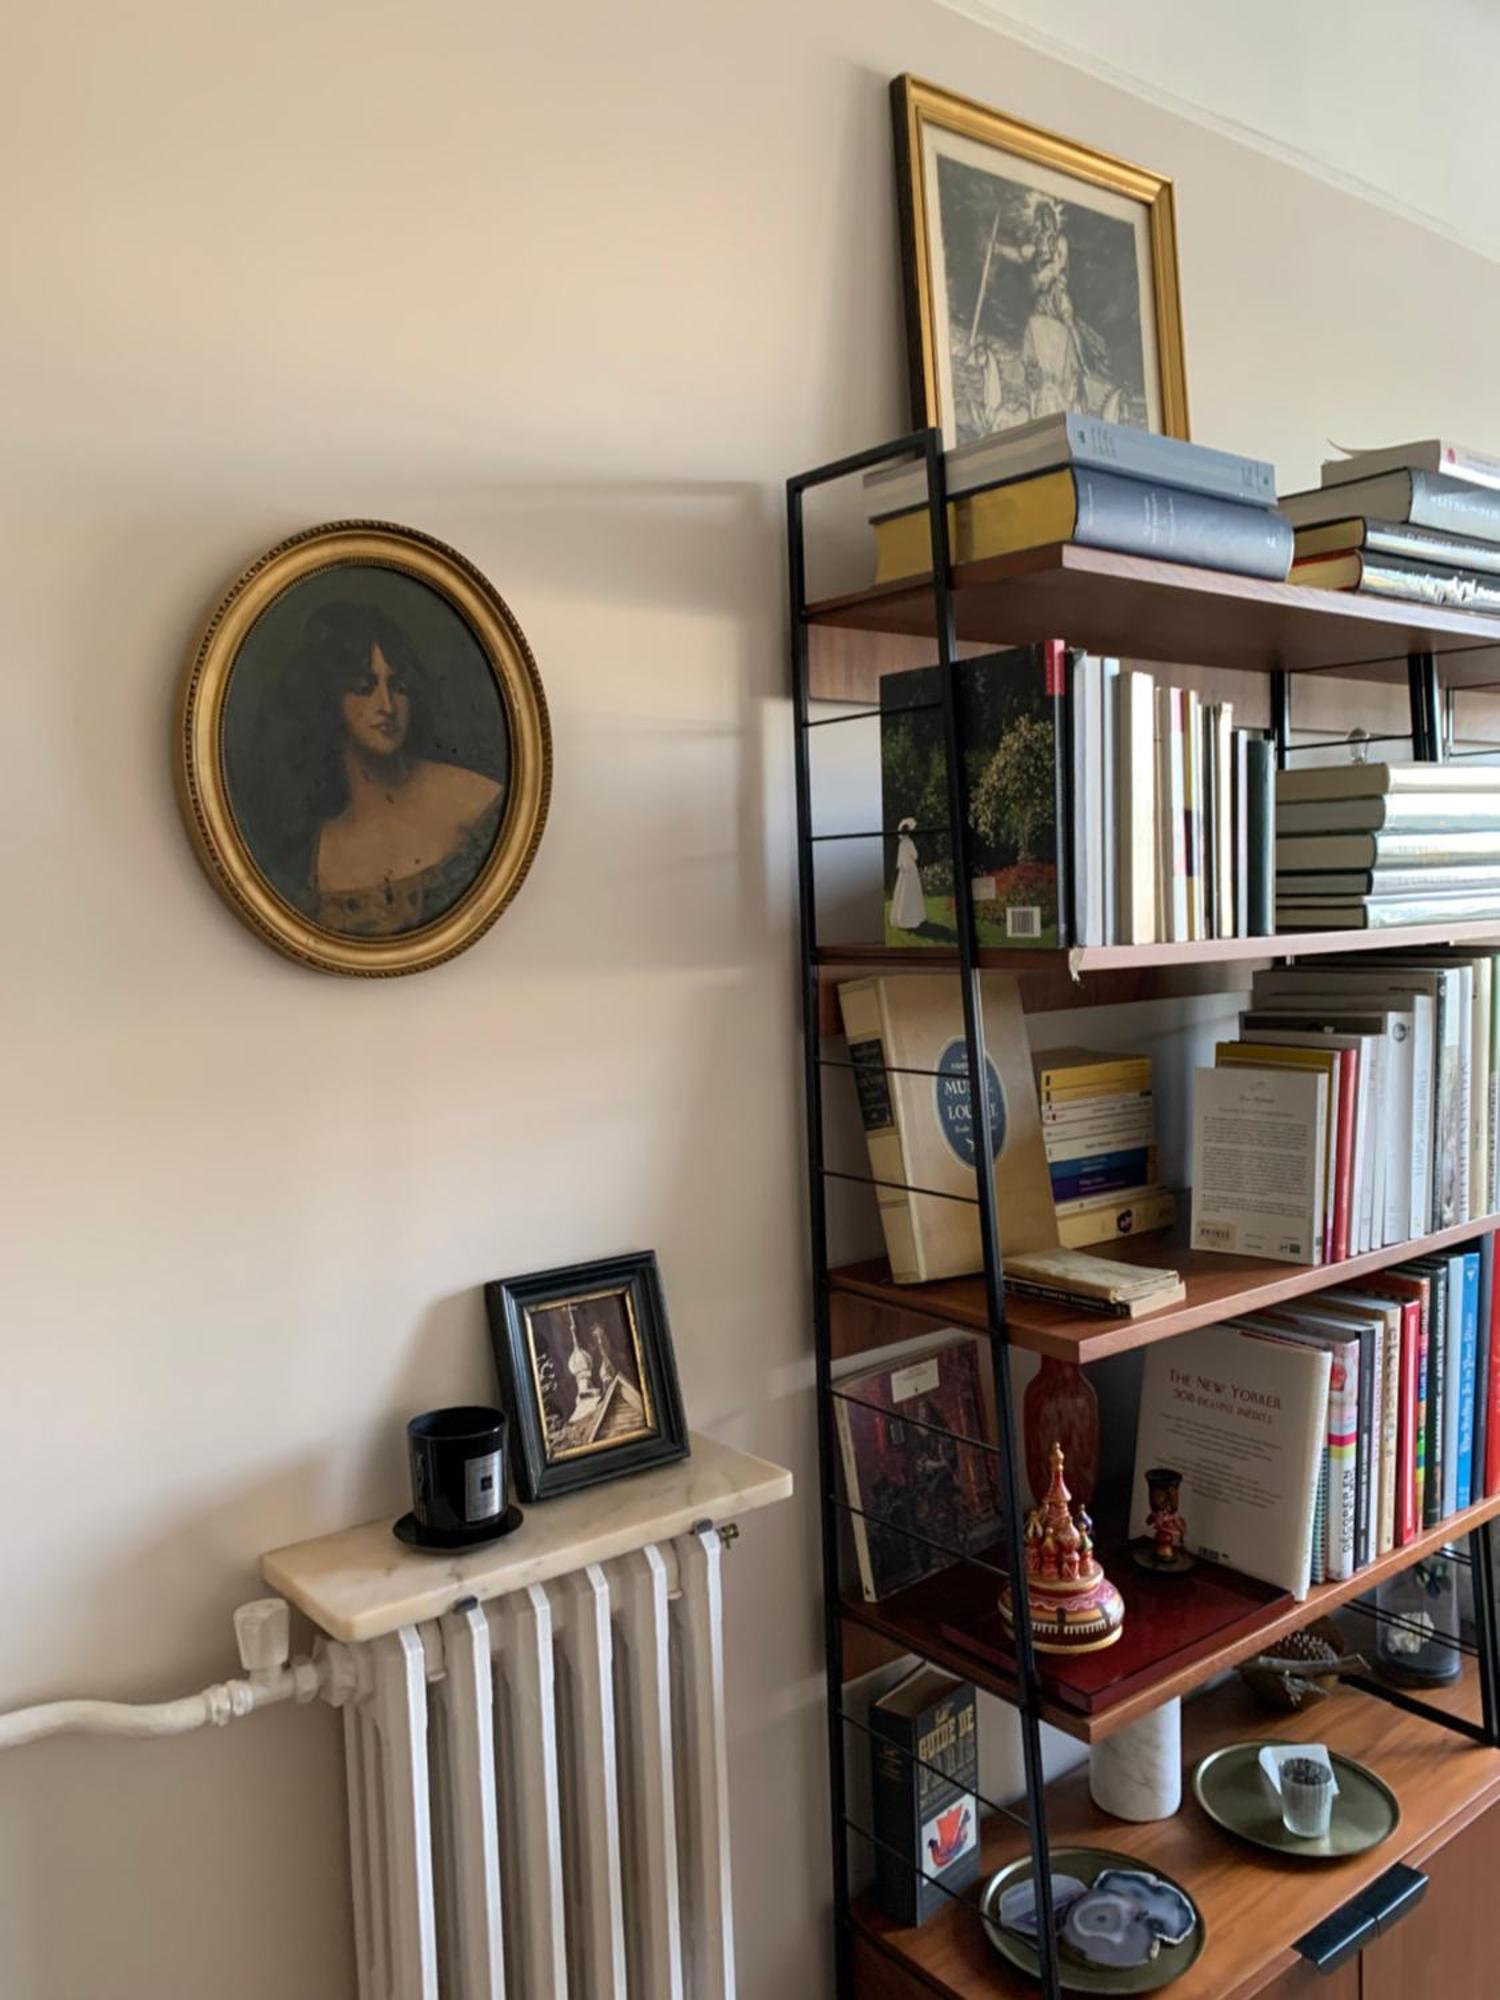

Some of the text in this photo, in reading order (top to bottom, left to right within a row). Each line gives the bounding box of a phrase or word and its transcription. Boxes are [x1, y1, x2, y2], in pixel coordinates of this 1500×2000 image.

[1168, 1368, 1281, 1409] THE NEW YORKER
[918, 1704, 975, 1760] GUIDE DE
